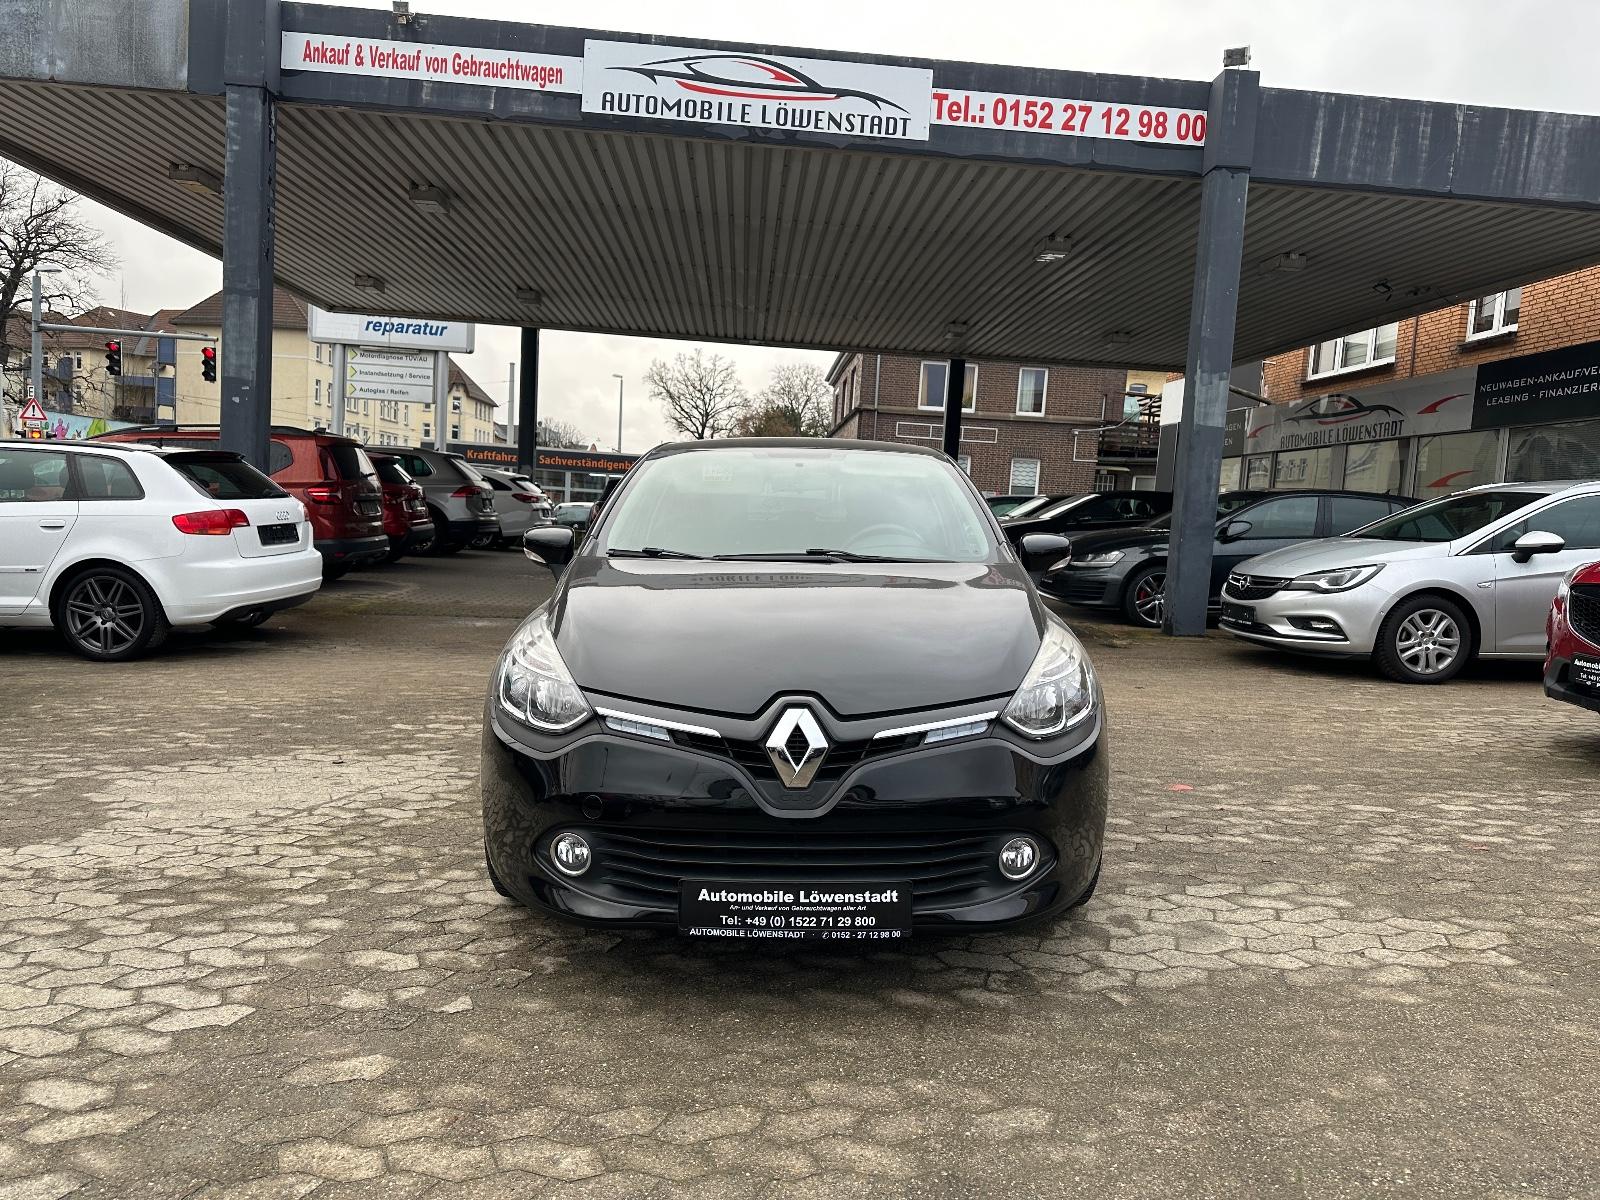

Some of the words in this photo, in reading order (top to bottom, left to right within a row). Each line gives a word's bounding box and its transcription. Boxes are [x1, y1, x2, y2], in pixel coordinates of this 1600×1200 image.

[303, 40, 350, 65] Ankauf
[355, 44, 364, 67] &
[369, 45, 421, 71] Verkauf
[425, 56, 447, 73] von
[452, 53, 563, 88] Gebrauchtwagen
[601, 92, 752, 123] AUTOMOBILE
[762, 103, 911, 136] LÖWENSTADT
[933, 93, 985, 123] Tel.:
[992, 98, 1054, 129] 0152
[1061, 104, 1092, 132] 27
[1101, 108, 1129, 135] 12
[1138, 111, 1168, 138] 98
[1176, 114, 1206, 142] 00
[365, 321, 447, 336] reparatur
[360, 352, 403, 360] Motordiagnose
[360, 370, 404, 378] Instandsetzung
[1486, 393, 1529, 406] LEASING
[1540, 382, 1600, 398] FINANZIER
[1280, 429, 1334, 448] AUTOMOBILE
[1336, 420, 1404, 444] LÖWENSTADT
[698, 889, 794, 903] Automobile
[799, 890, 898, 903] Löwenstadt
[720, 916, 741, 925] Tel:
[745, 916, 767, 926] +49
[770, 916, 785, 927] (0)
[789, 917, 816, 926] 1522
[820, 917, 833, 926] 71
[838, 917, 852, 926] 29
[854, 917, 876, 926] 800
[690, 928, 745, 936] AUTOMOBILE
[748, 929, 806, 938] LÖWENSTADT
